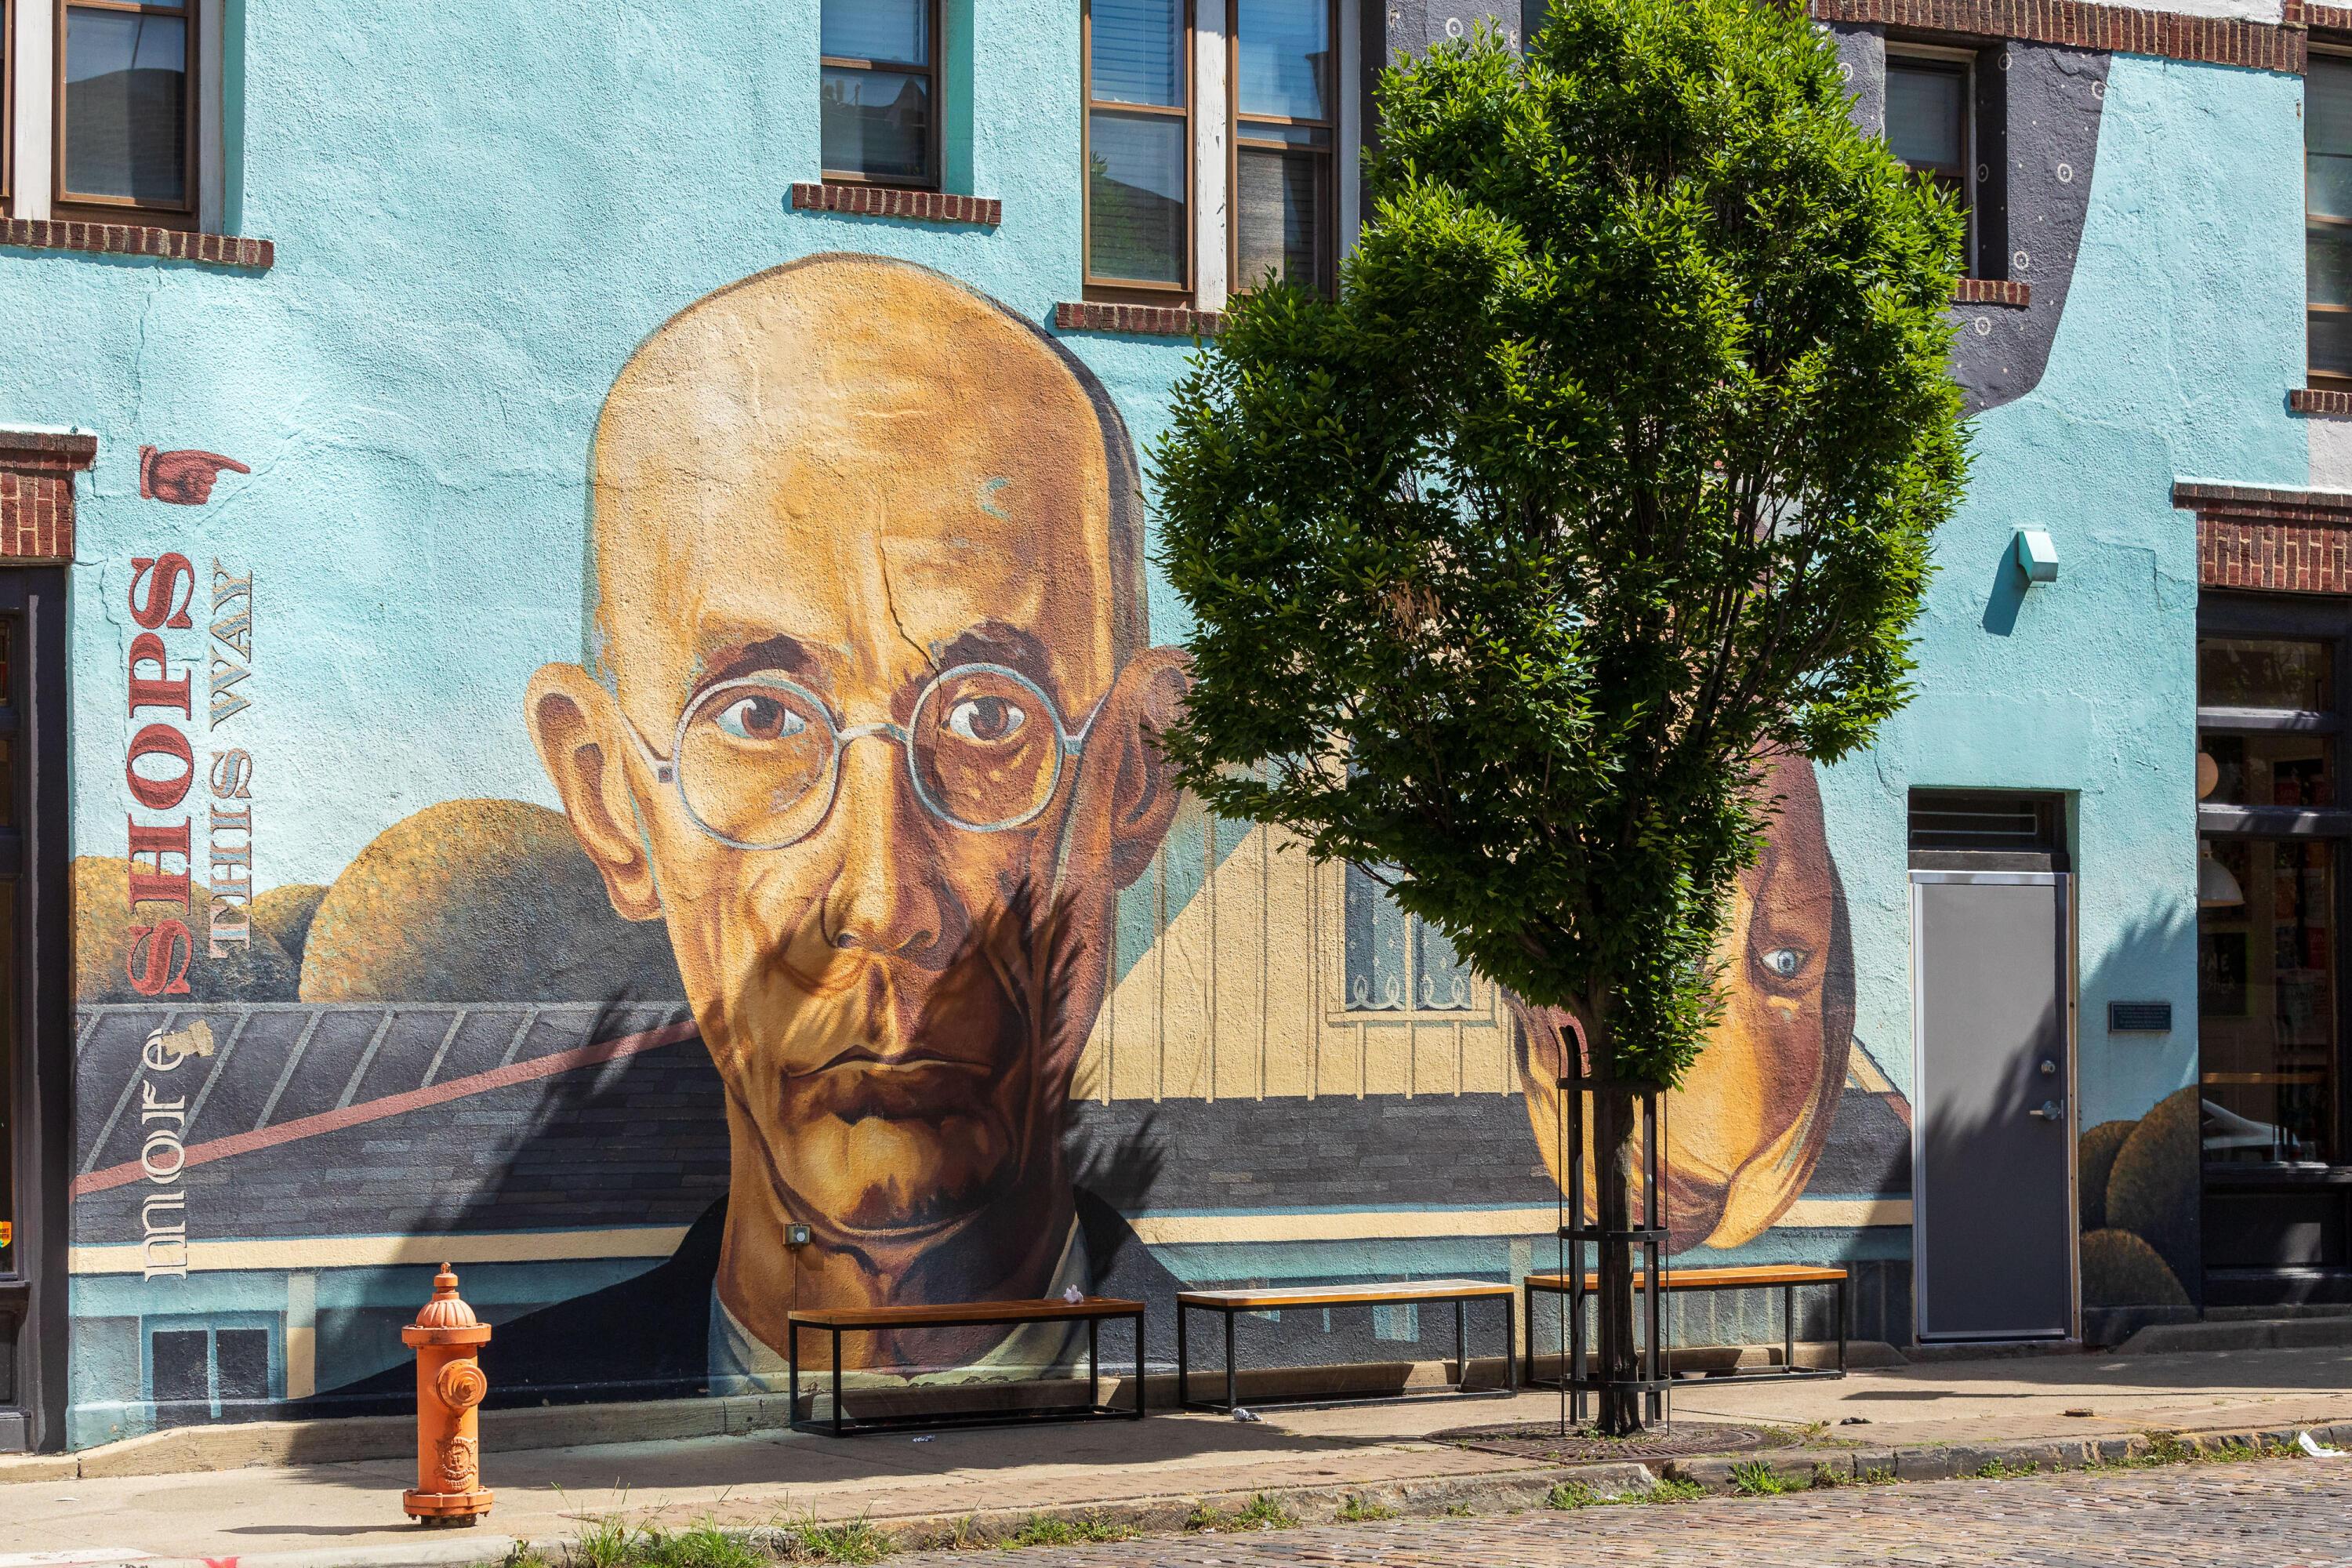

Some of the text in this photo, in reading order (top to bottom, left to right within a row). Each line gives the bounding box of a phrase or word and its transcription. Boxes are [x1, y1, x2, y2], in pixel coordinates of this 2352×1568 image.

[127, 551, 194, 996] SHOPS
[209, 557, 252, 959] THIS WAY
[141, 1028, 187, 1283] more
